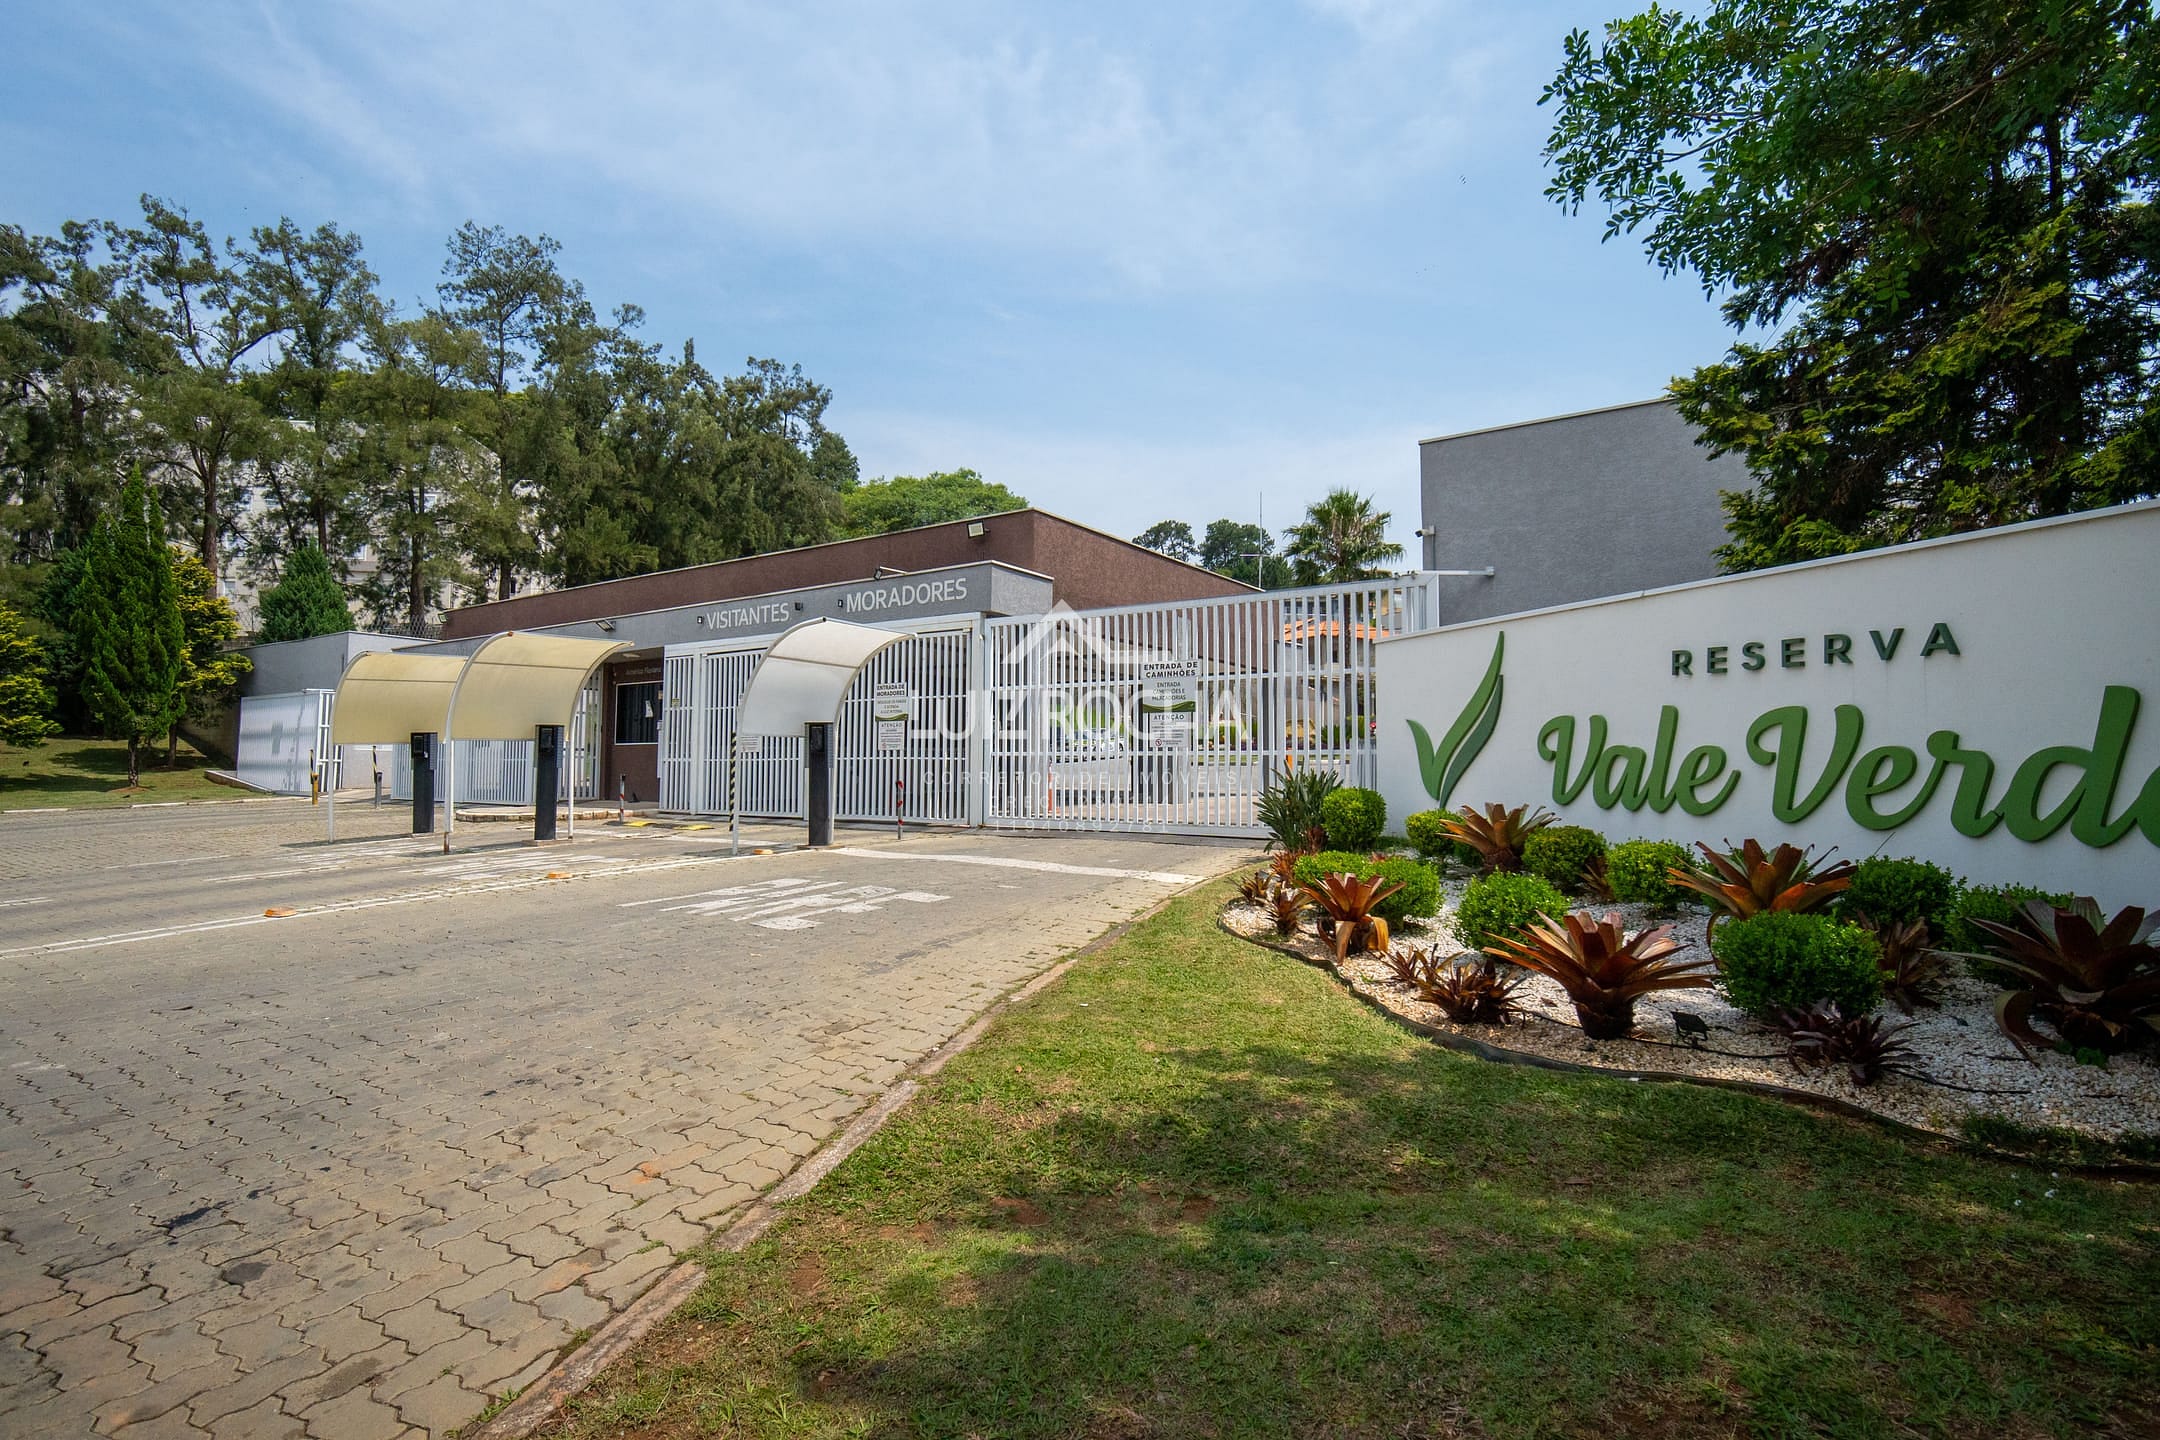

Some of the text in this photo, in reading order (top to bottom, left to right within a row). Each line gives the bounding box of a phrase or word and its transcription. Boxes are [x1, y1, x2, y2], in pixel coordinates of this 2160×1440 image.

[846, 577, 968, 614] MORADORES
[705, 602, 790, 631] VISITANTES
[1671, 622, 1961, 676] RESERVA
[1144, 661, 1198, 671] ENTRADA DE
[1146, 669, 1196, 678] CAMINHÕES
[1536, 685, 2160, 849] Vale Verd
